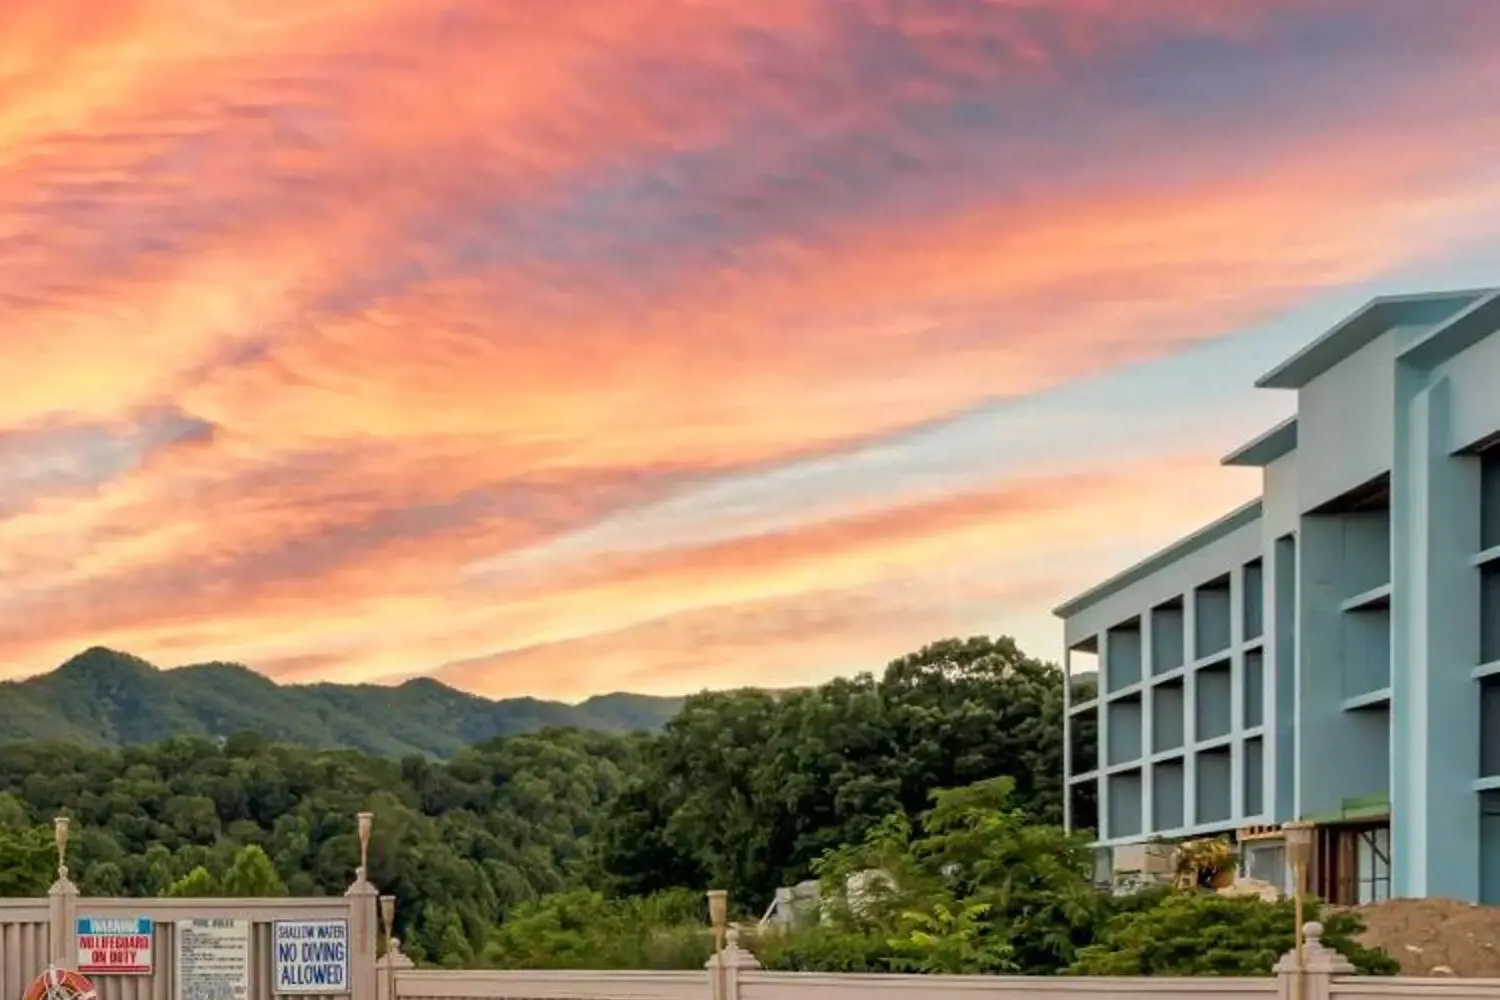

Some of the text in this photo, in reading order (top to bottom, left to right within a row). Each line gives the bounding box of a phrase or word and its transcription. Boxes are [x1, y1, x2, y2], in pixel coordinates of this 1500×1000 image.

[278, 925, 345, 938] SHALLOW WATER
[80, 936, 149, 949] NO LIFEGUARD
[91, 951, 137, 963] ON DUTY
[279, 941, 344, 962] NO DIVING
[280, 964, 342, 985] ALLOWED
